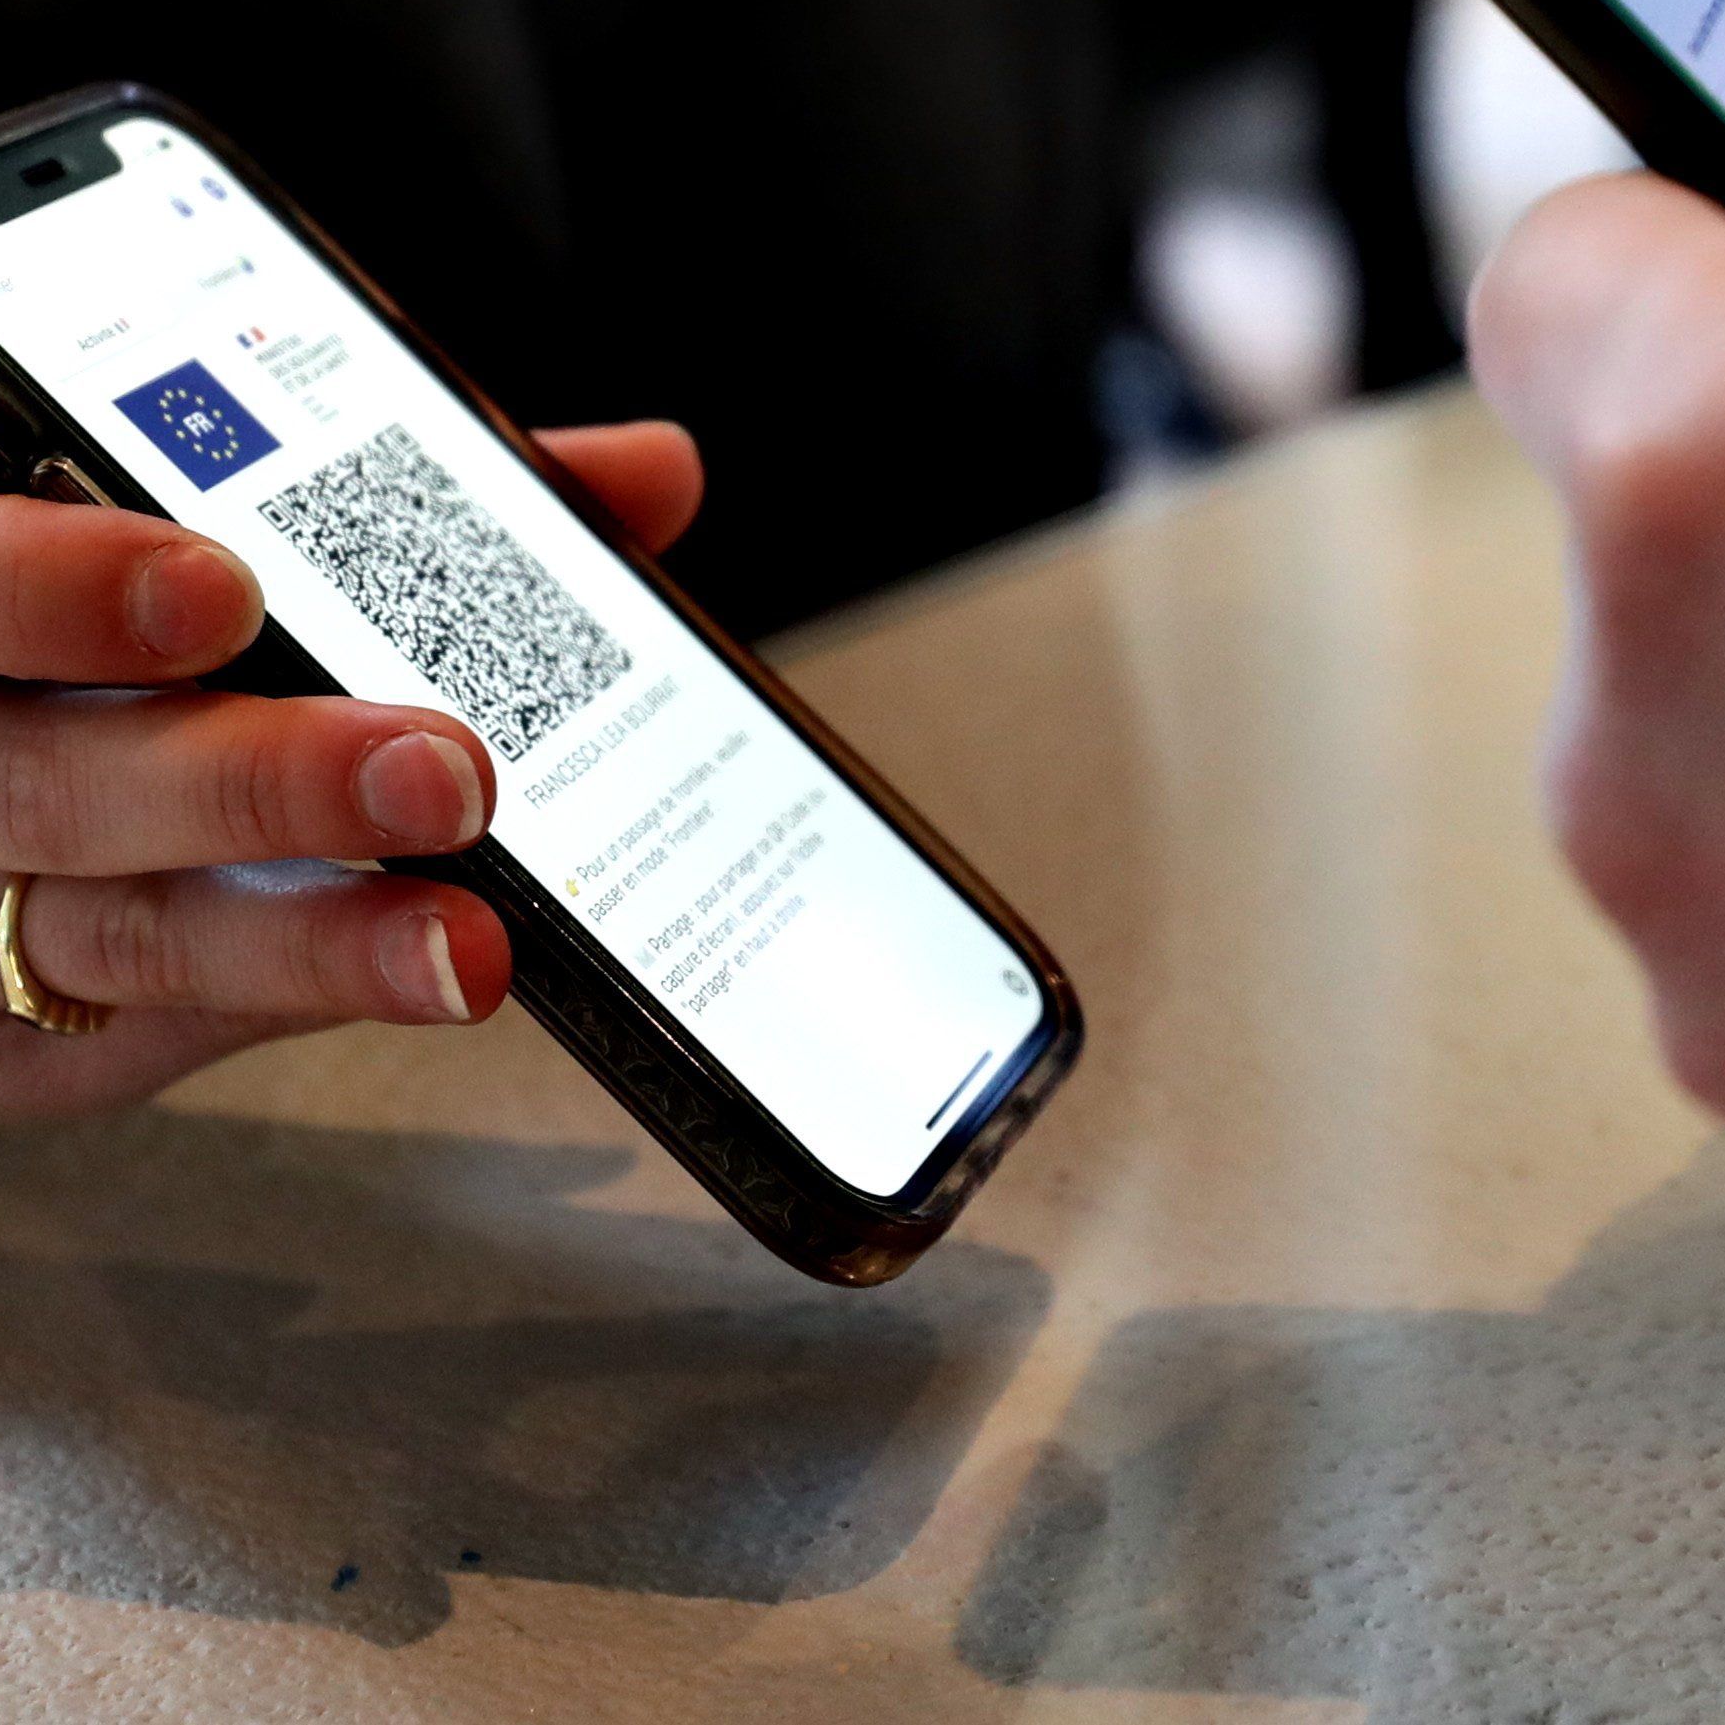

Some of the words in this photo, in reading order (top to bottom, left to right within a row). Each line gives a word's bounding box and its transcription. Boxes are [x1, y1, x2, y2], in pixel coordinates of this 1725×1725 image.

[182, 410, 216, 438] FR
[524, 739, 608, 810] FRANCESCA
[599, 720, 628, 751] LEA
[576, 853, 608, 884] Pour
[607, 841, 625, 862] un
[618, 805, 664, 853] passage
[658, 793, 678, 814] de
[587, 884, 628, 925] passer
[622, 870, 642, 891] en
[635, 845, 670, 878] mode
[694, 883, 723, 916] pour
[660, 950, 703, 994] capture
[775, 858, 797, 881] sur
[732, 946, 753, 969] en
